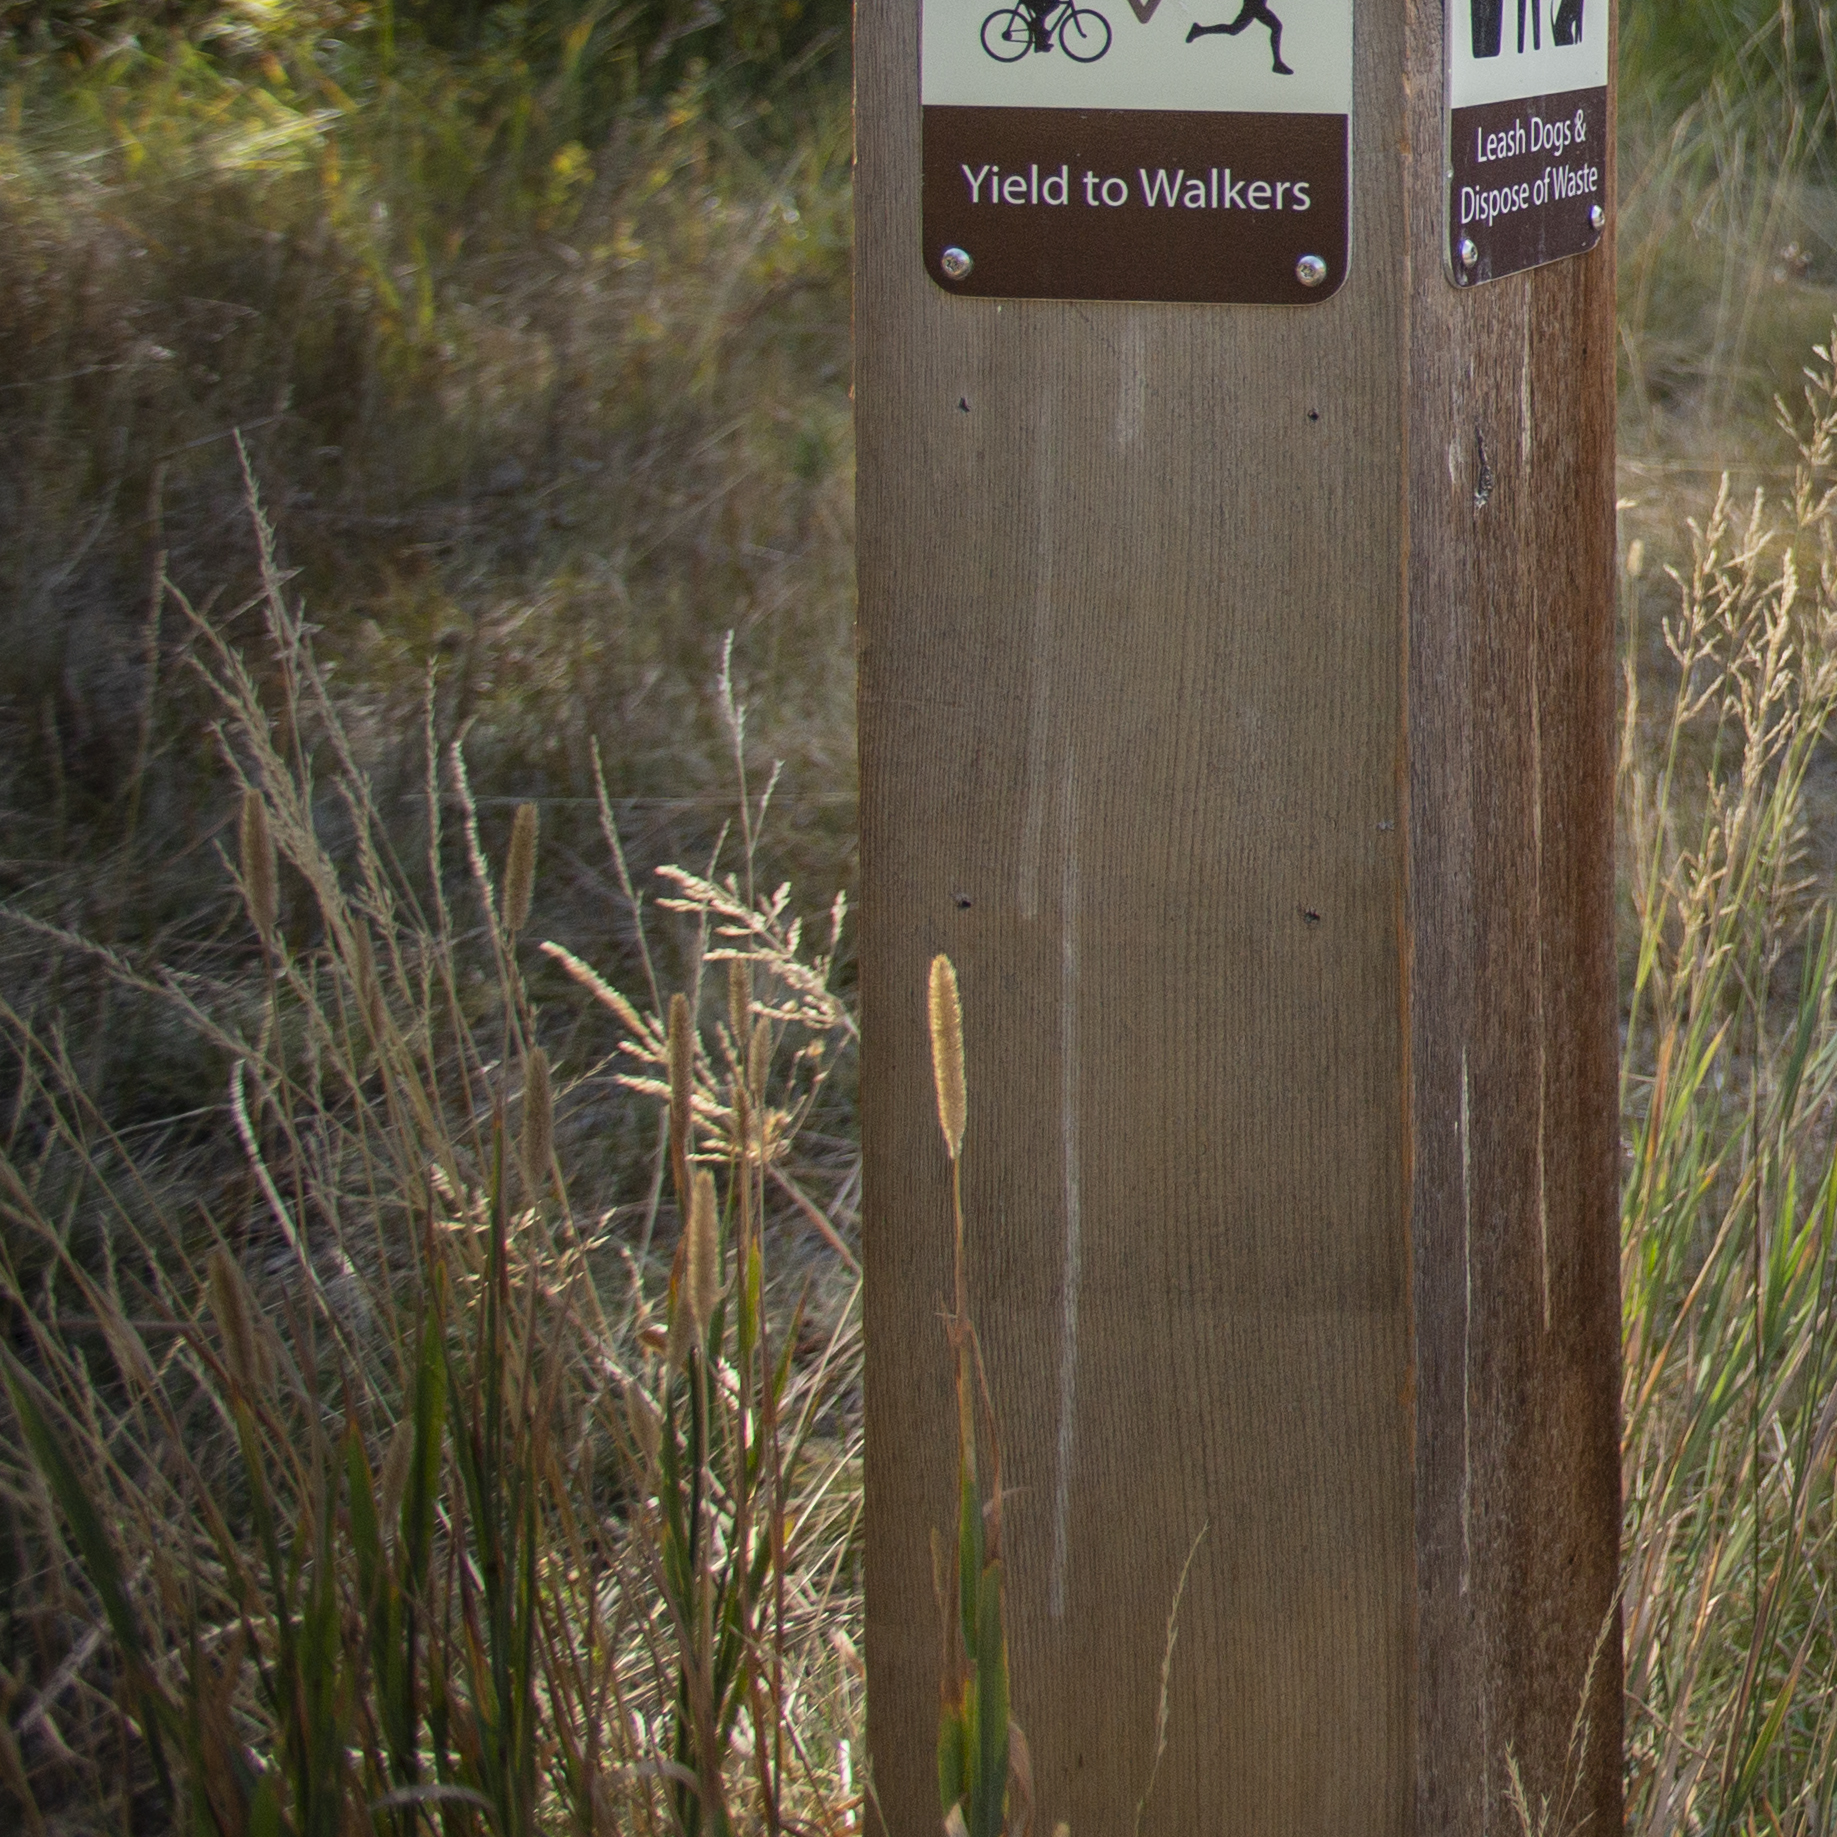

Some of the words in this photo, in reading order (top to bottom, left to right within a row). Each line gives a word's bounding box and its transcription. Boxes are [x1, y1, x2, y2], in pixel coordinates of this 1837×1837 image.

[1477, 118, 1526, 162] Leash
[1530, 117, 1571, 156] Dogs
[1574, 109, 1586, 142] &
[962, 164, 1069, 205] Yield
[1083, 170, 1128, 206] to
[1139, 168, 1311, 211] Walkers
[1461, 183, 1529, 227] Dispose
[1533, 167, 1551, 205] of
[1552, 163, 1598, 200] Waste
